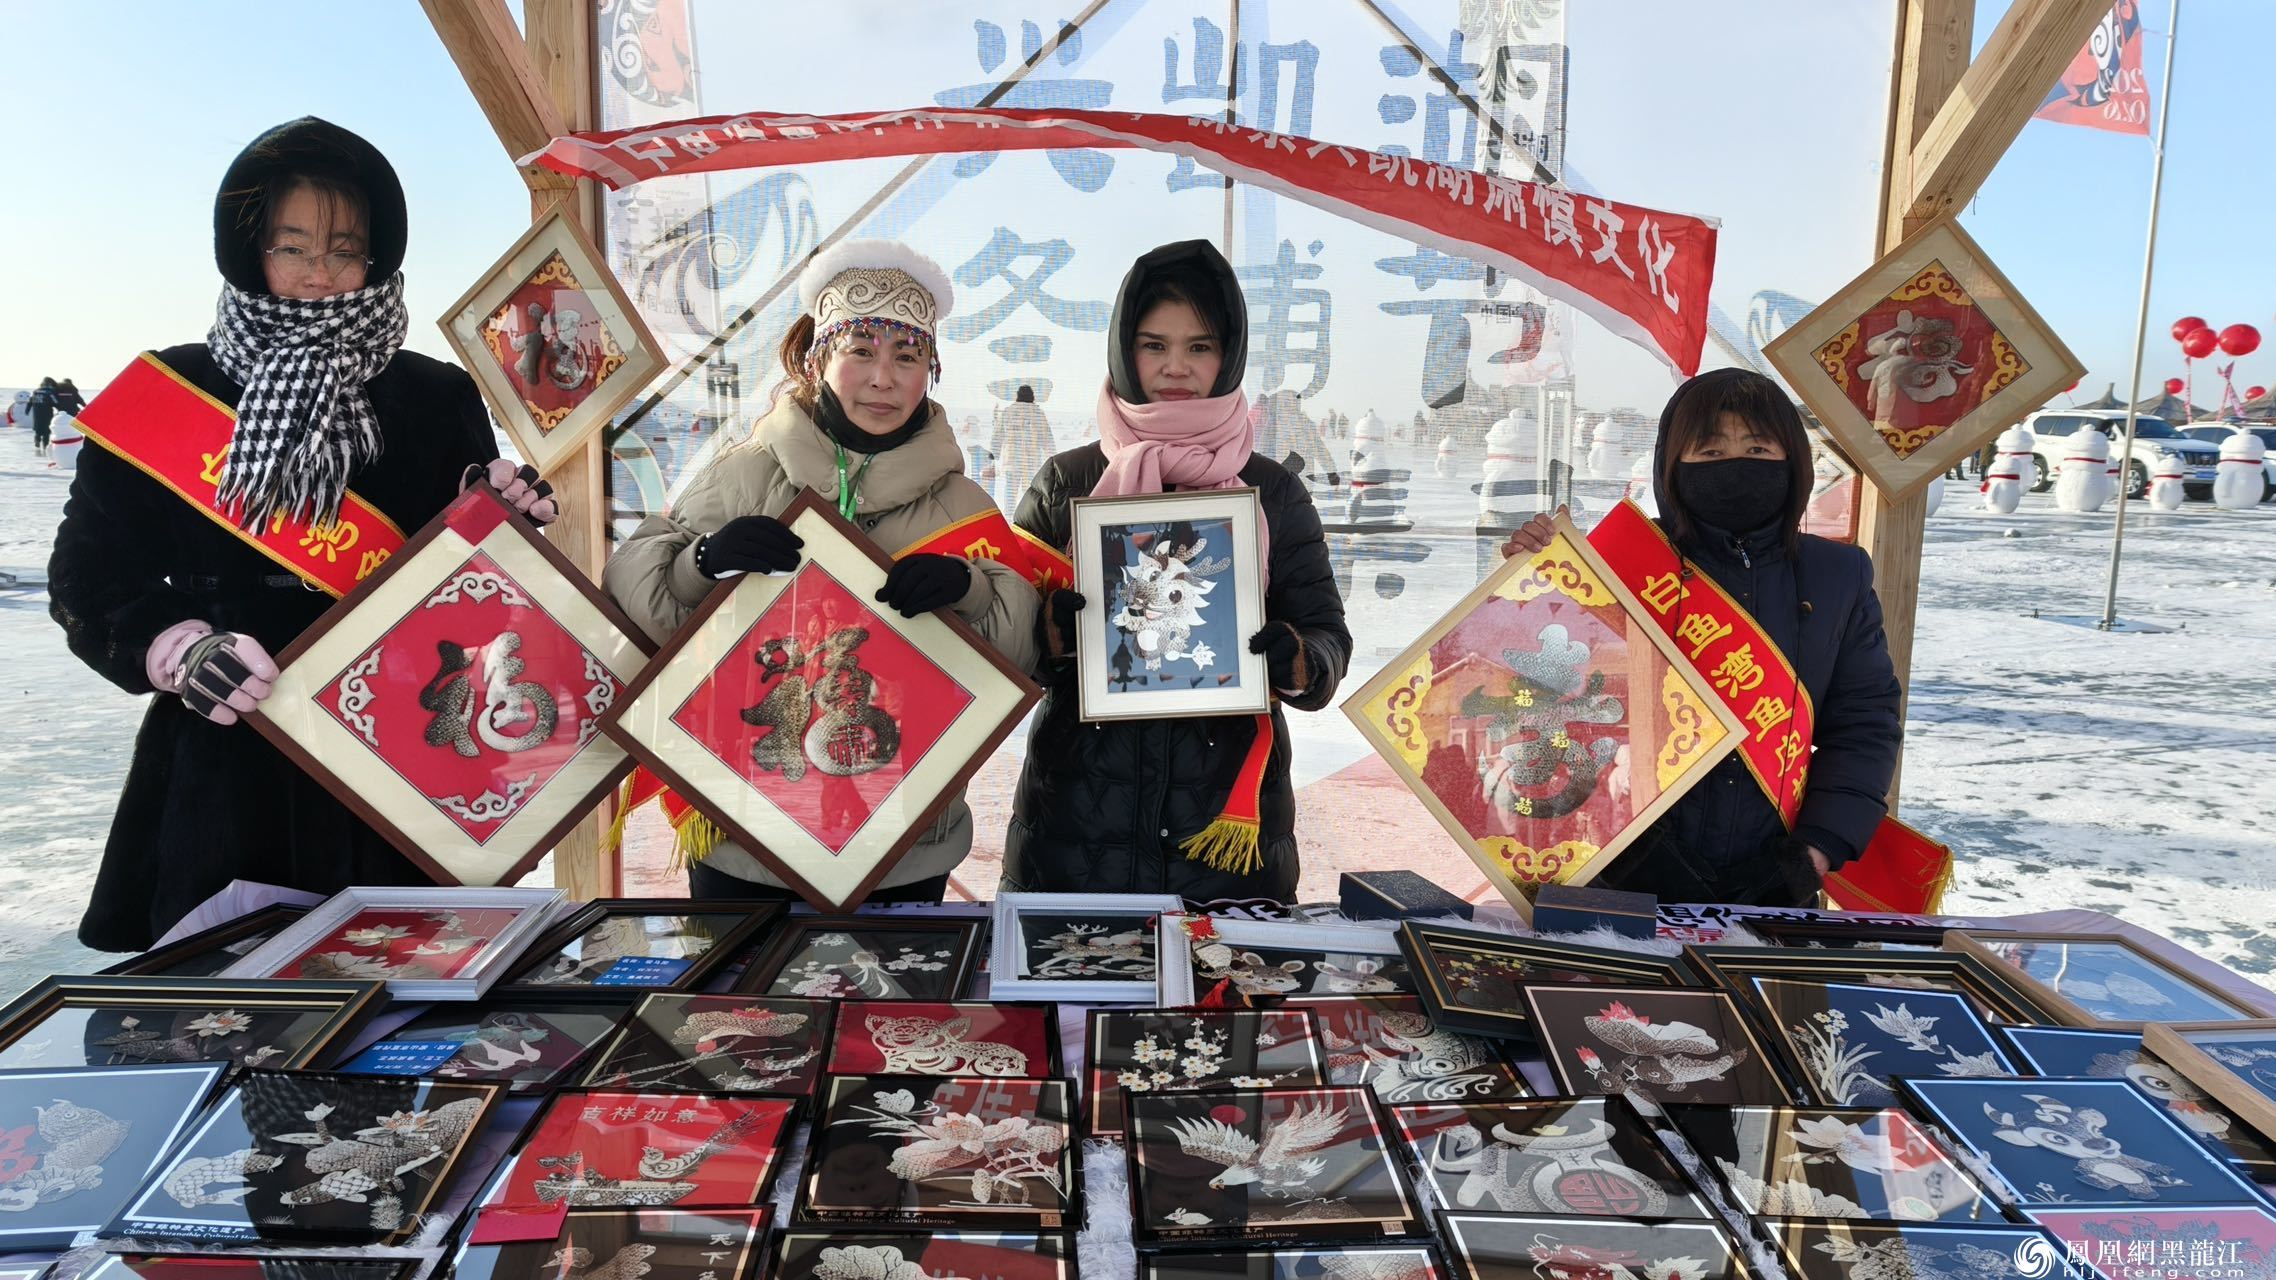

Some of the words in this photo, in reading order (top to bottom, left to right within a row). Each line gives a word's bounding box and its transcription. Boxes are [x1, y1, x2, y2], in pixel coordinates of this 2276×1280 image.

[582, 1105, 698, 1123] 吉祥如意
[130, 1222, 247, 1234] 中国非物质文化遗产
